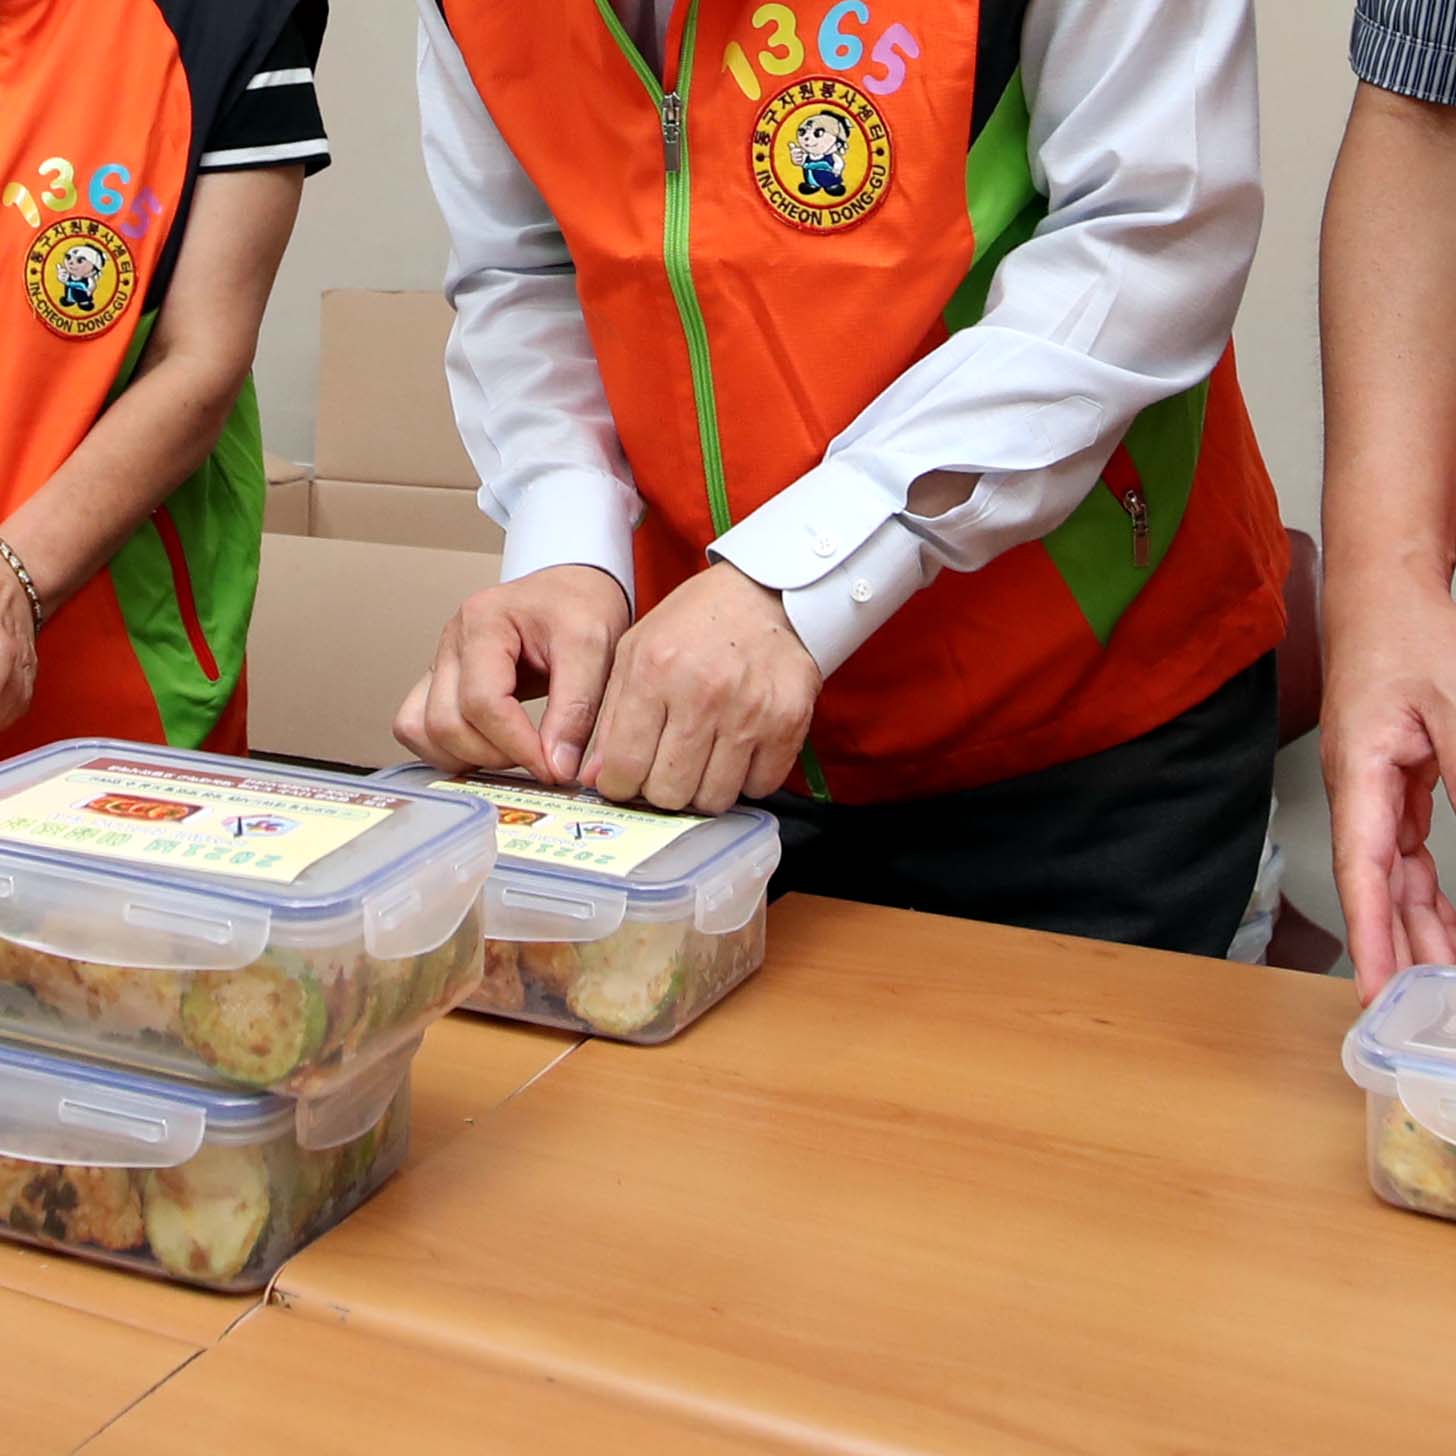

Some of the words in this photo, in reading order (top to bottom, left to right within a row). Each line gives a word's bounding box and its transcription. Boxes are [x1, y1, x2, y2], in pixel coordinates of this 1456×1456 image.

[721, 0, 920, 101] 1365
[754, 81, 885, 146] 동구자원봉사센터
[2, 157, 163, 239] 1365
[755, 169, 823, 226] IN-CHEON
[830, 164, 887, 226] DONG-GU
[29, 281, 73, 332] IN-CHEON
[77, 291, 128, 333] DONG-GU
